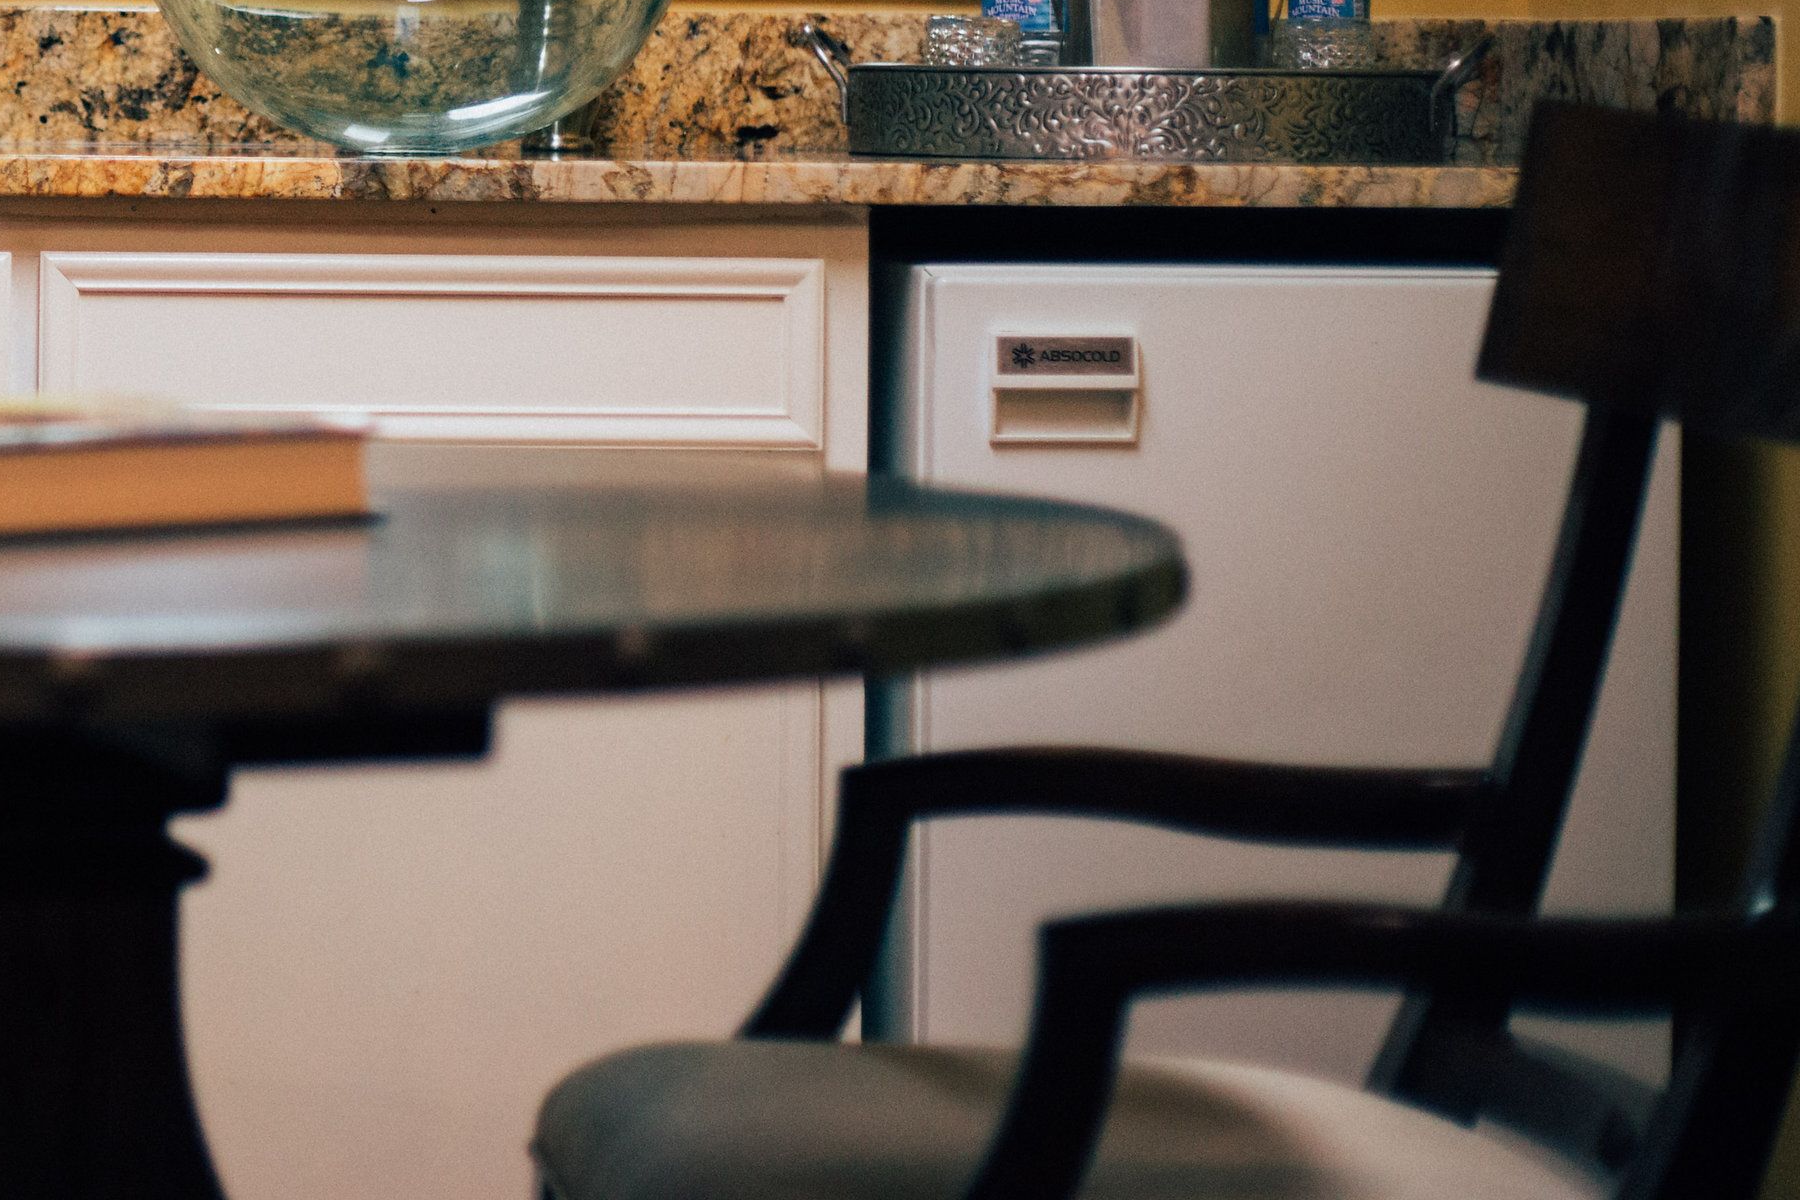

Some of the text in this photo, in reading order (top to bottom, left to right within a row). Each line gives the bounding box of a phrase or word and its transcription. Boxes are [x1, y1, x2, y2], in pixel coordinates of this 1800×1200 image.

[987, 3, 1038, 17] MOUNTAIN
[1292, 4, 1341, 18] MOUNTAIN
[1040, 350, 1121, 363] ABSOCOLD
